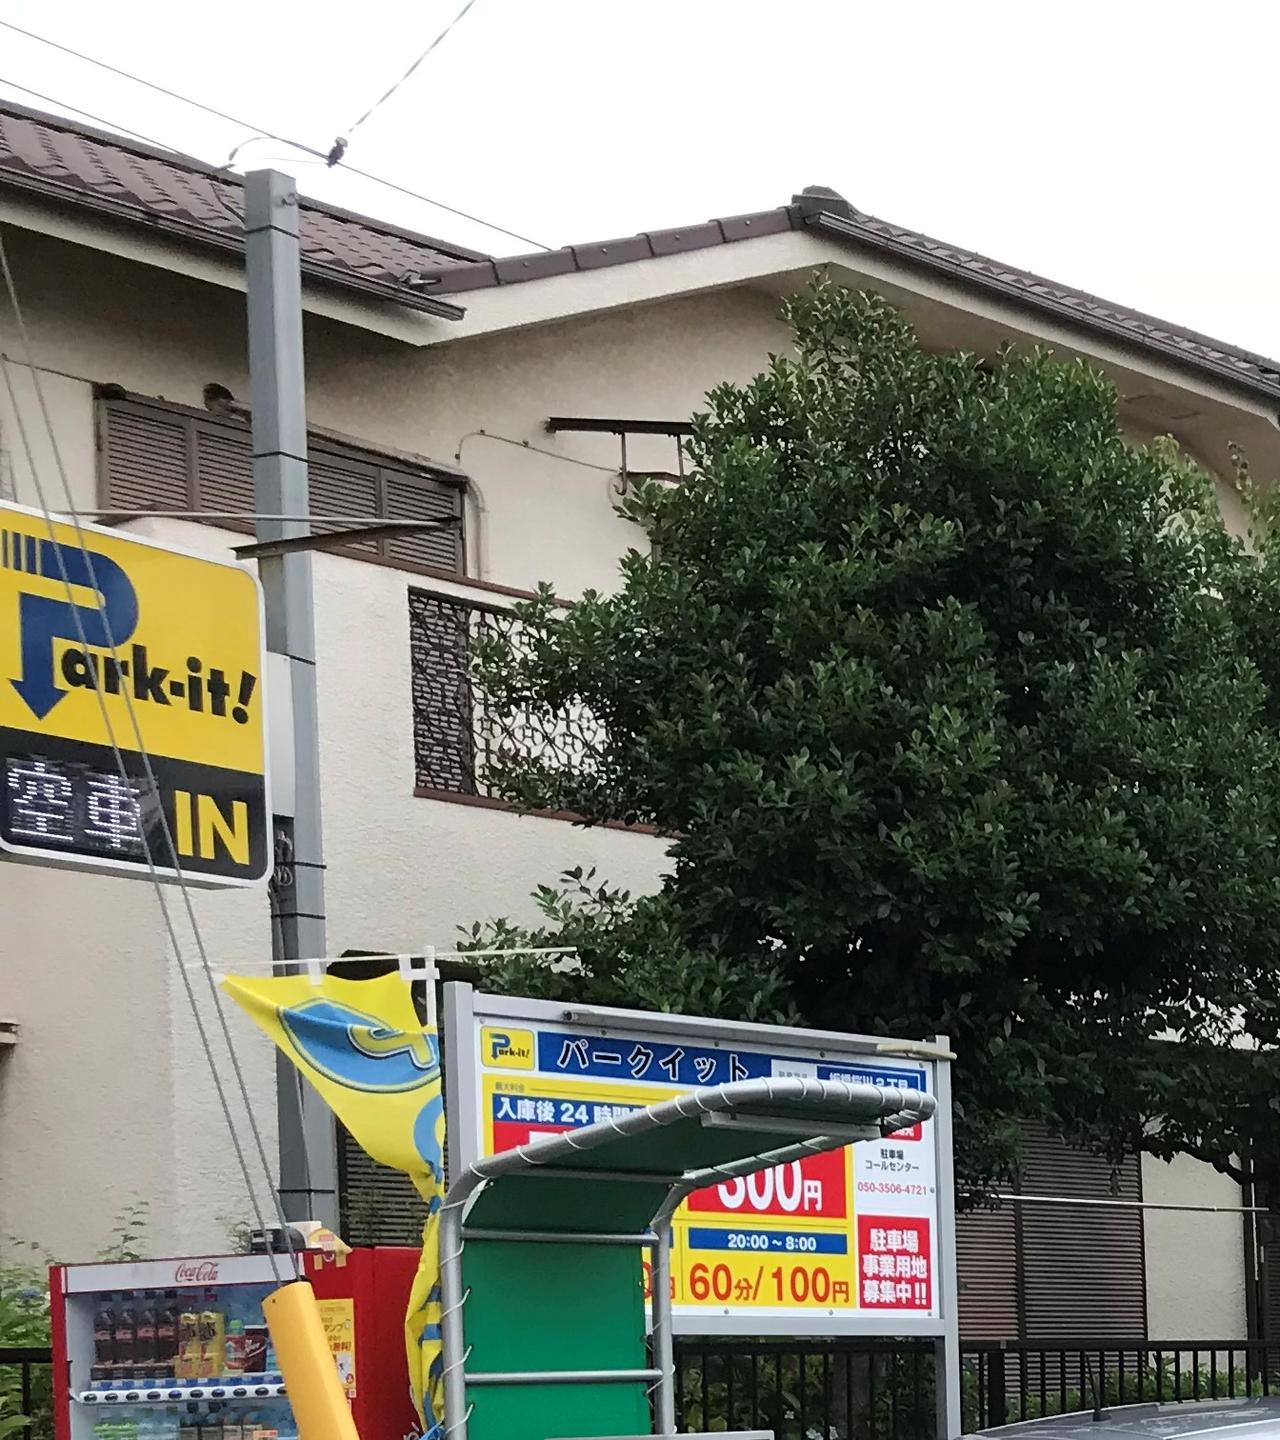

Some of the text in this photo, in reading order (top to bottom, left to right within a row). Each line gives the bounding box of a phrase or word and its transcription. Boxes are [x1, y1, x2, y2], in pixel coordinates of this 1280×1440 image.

[7, 762, 143, 849] 空車
[173, 789, 250, 866] IN
[556, 1038, 749, 1082] パークイット
[865, 1160, 920, 1172] コールセンター
[880, 1149, 904, 1160] 駐車場
[857, 1182, 928, 1195] 050-3506-4721
[870, 1228, 919, 1253] 駐車場
[862, 1253, 928, 1279] 事業用地
